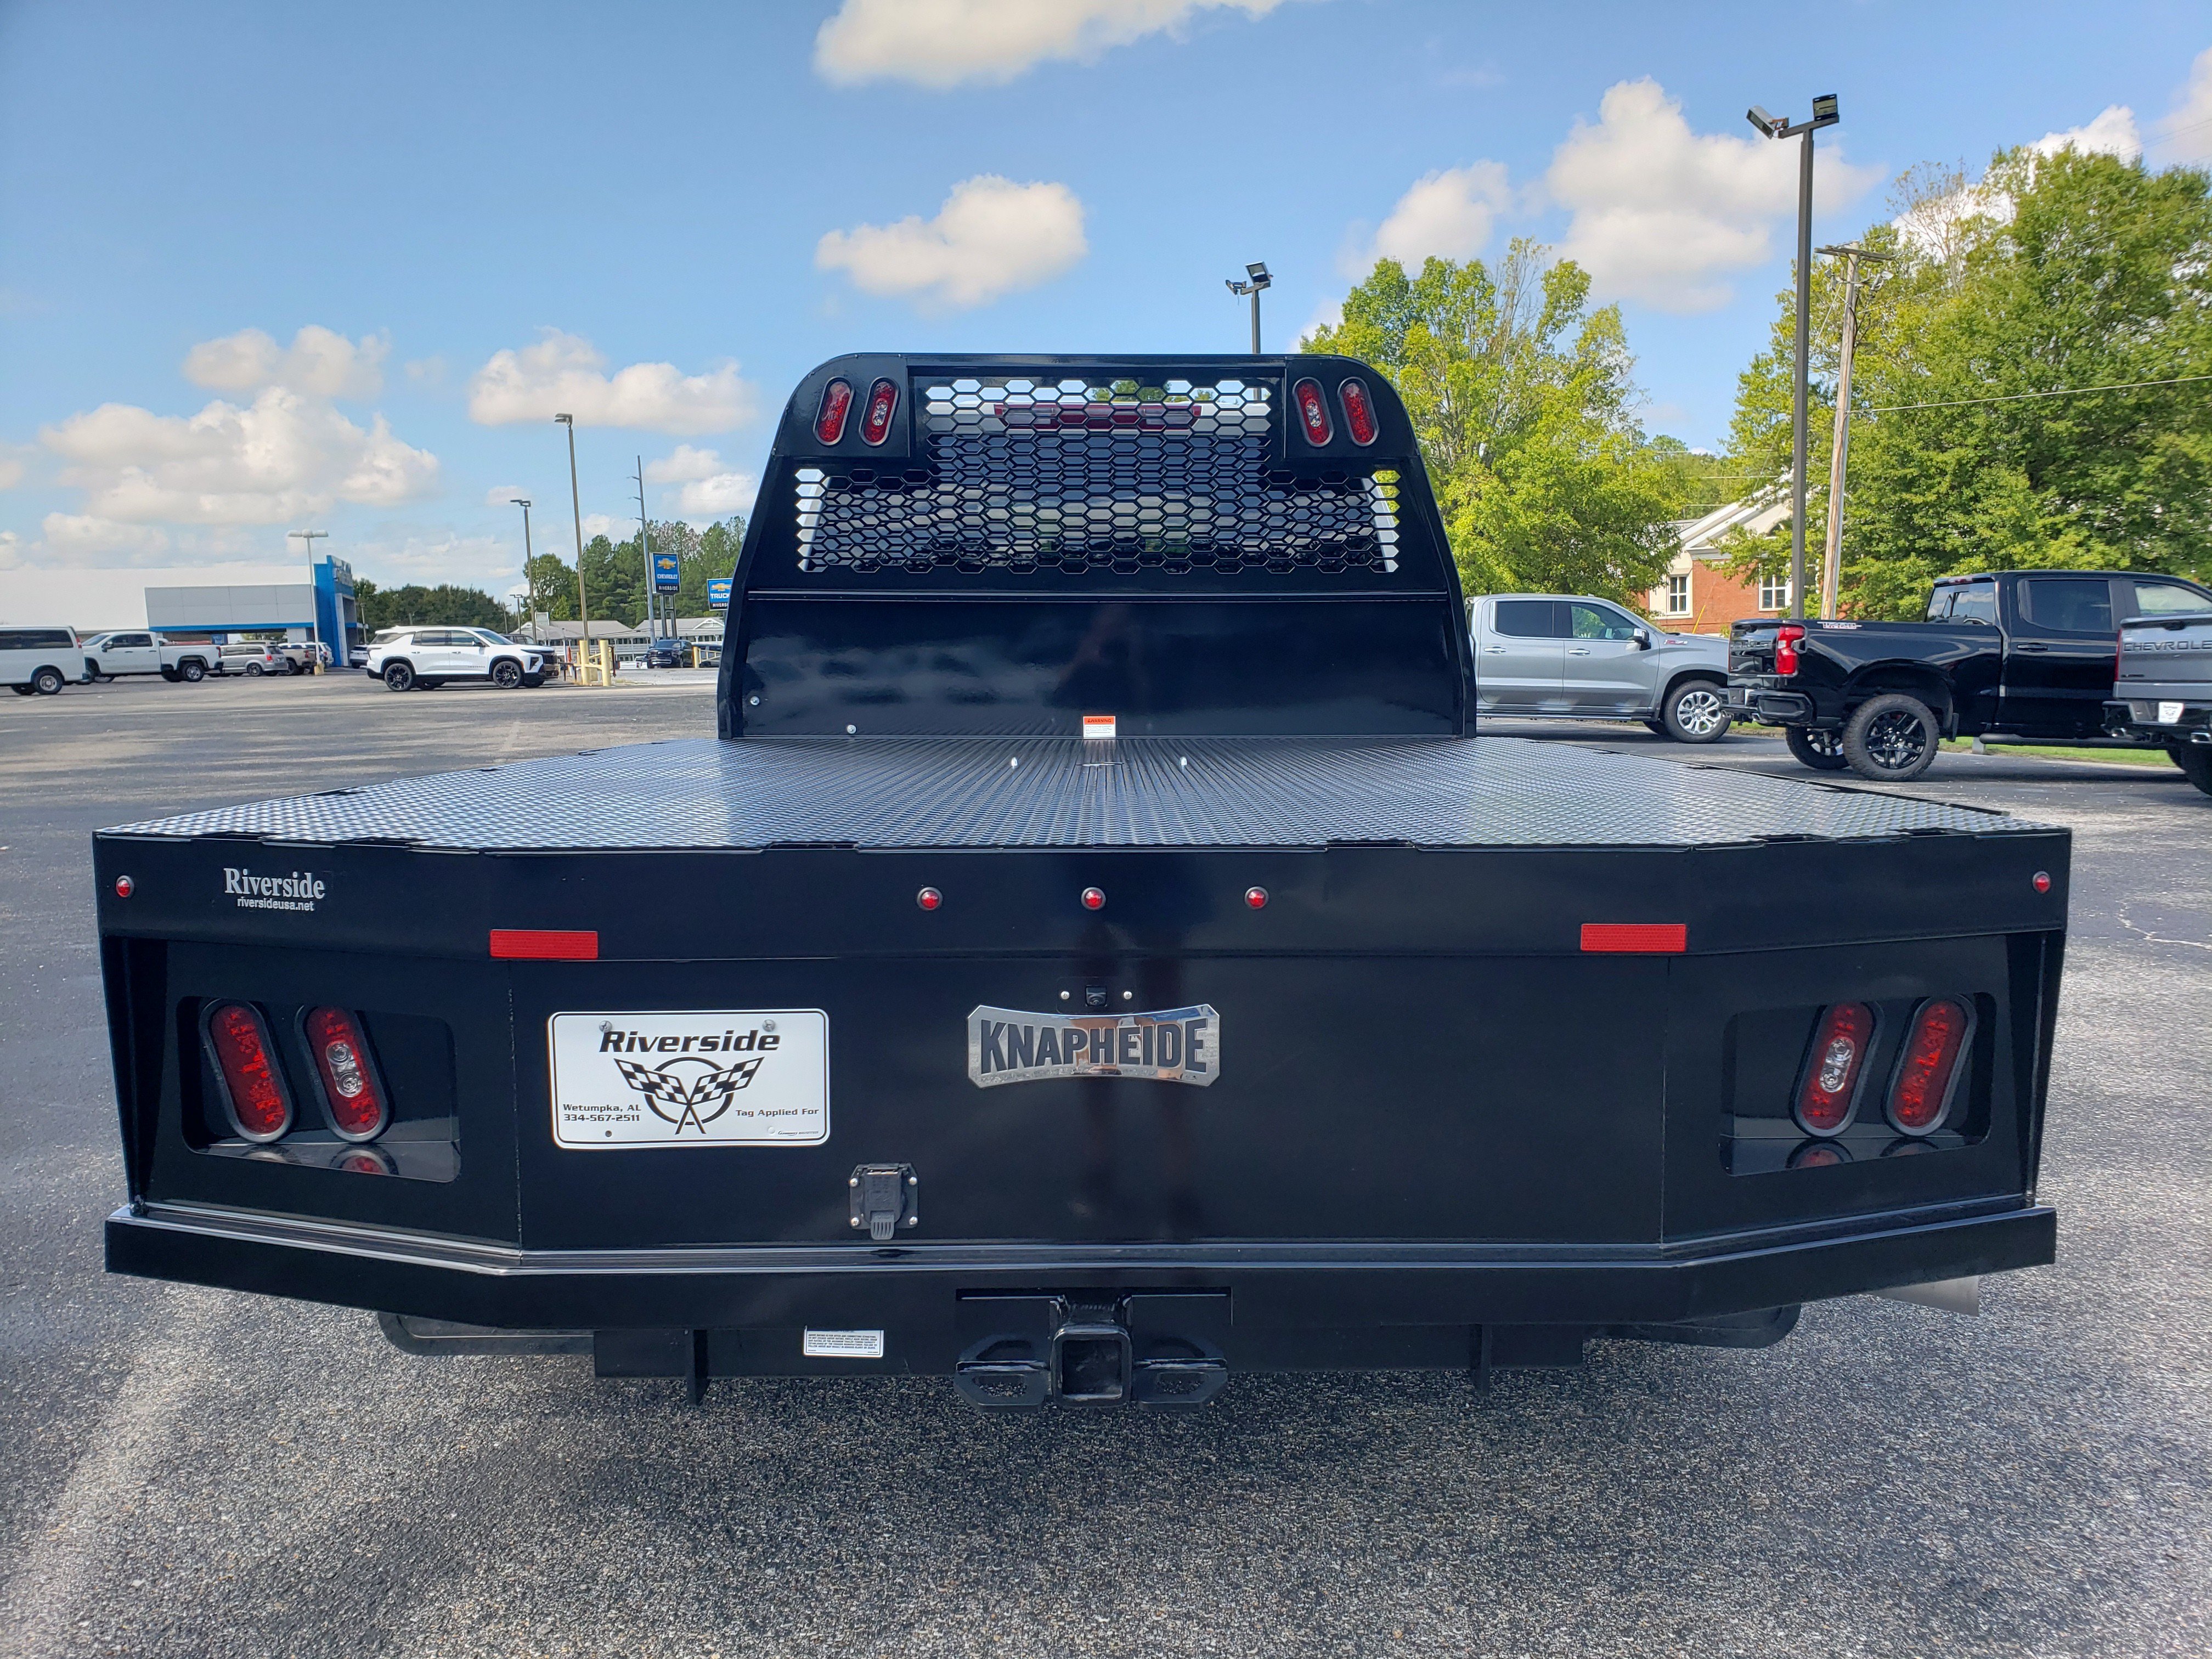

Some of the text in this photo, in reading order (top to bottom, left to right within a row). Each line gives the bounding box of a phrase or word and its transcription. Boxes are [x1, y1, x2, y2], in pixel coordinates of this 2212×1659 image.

[223, 868, 325, 899] Riverside
[237, 896, 314, 911] riversideusa.net
[599, 1030, 780, 1053] Riverside
[981, 1018, 1207, 1074] KNAPHEIDE
[563, 1104, 623, 1113] Wetumpka,
[736, 1109, 754, 1118] Tag
[757, 1109, 798, 1117] Applied
[564, 1114, 640, 1122] 334-567-2511
